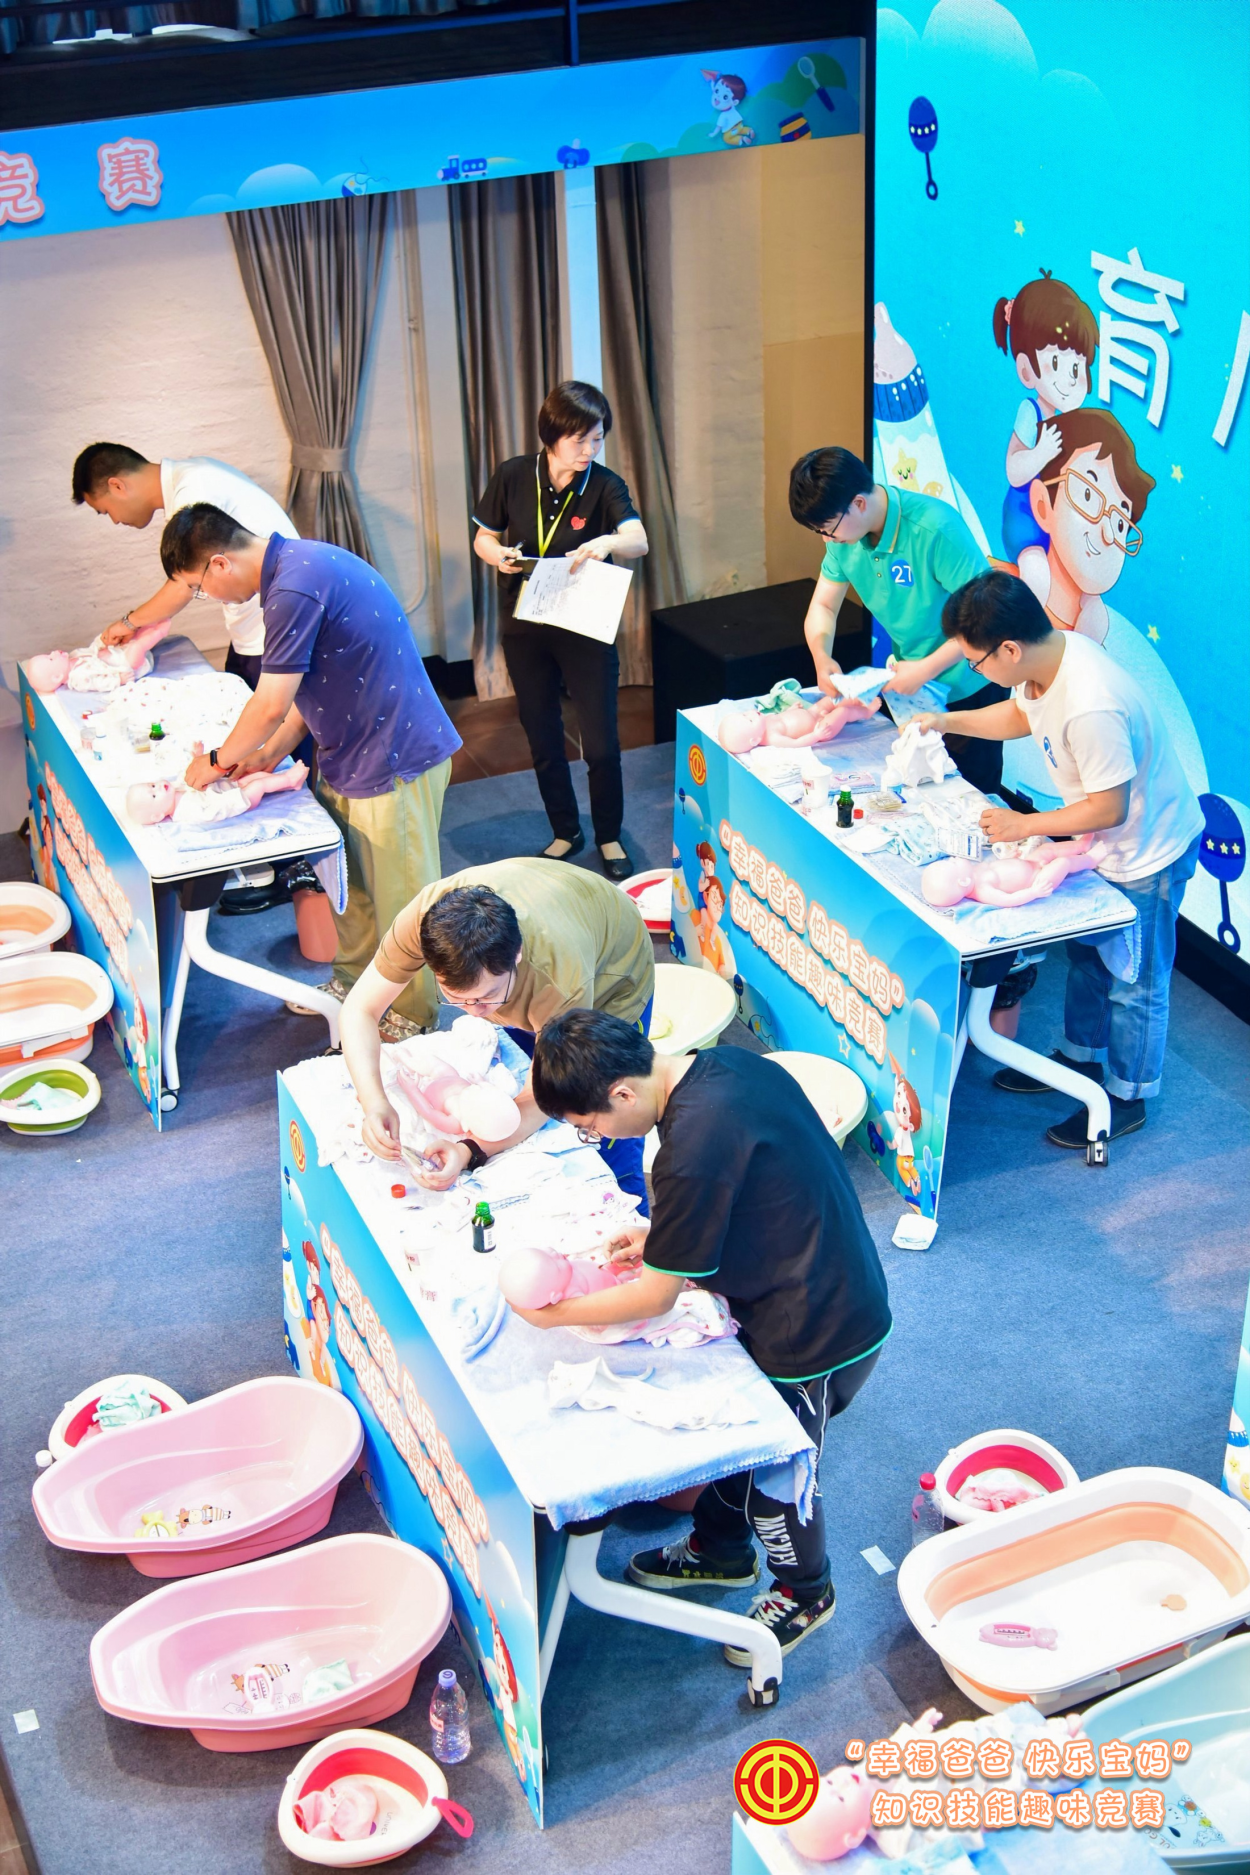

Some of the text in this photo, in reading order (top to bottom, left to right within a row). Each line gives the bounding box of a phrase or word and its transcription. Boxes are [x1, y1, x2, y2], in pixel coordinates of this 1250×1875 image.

[891, 565, 913, 583] 27
[731, 883, 885, 1061] 知识技能趣味竞赛
[754, 1513, 798, 1565] MICKEY
